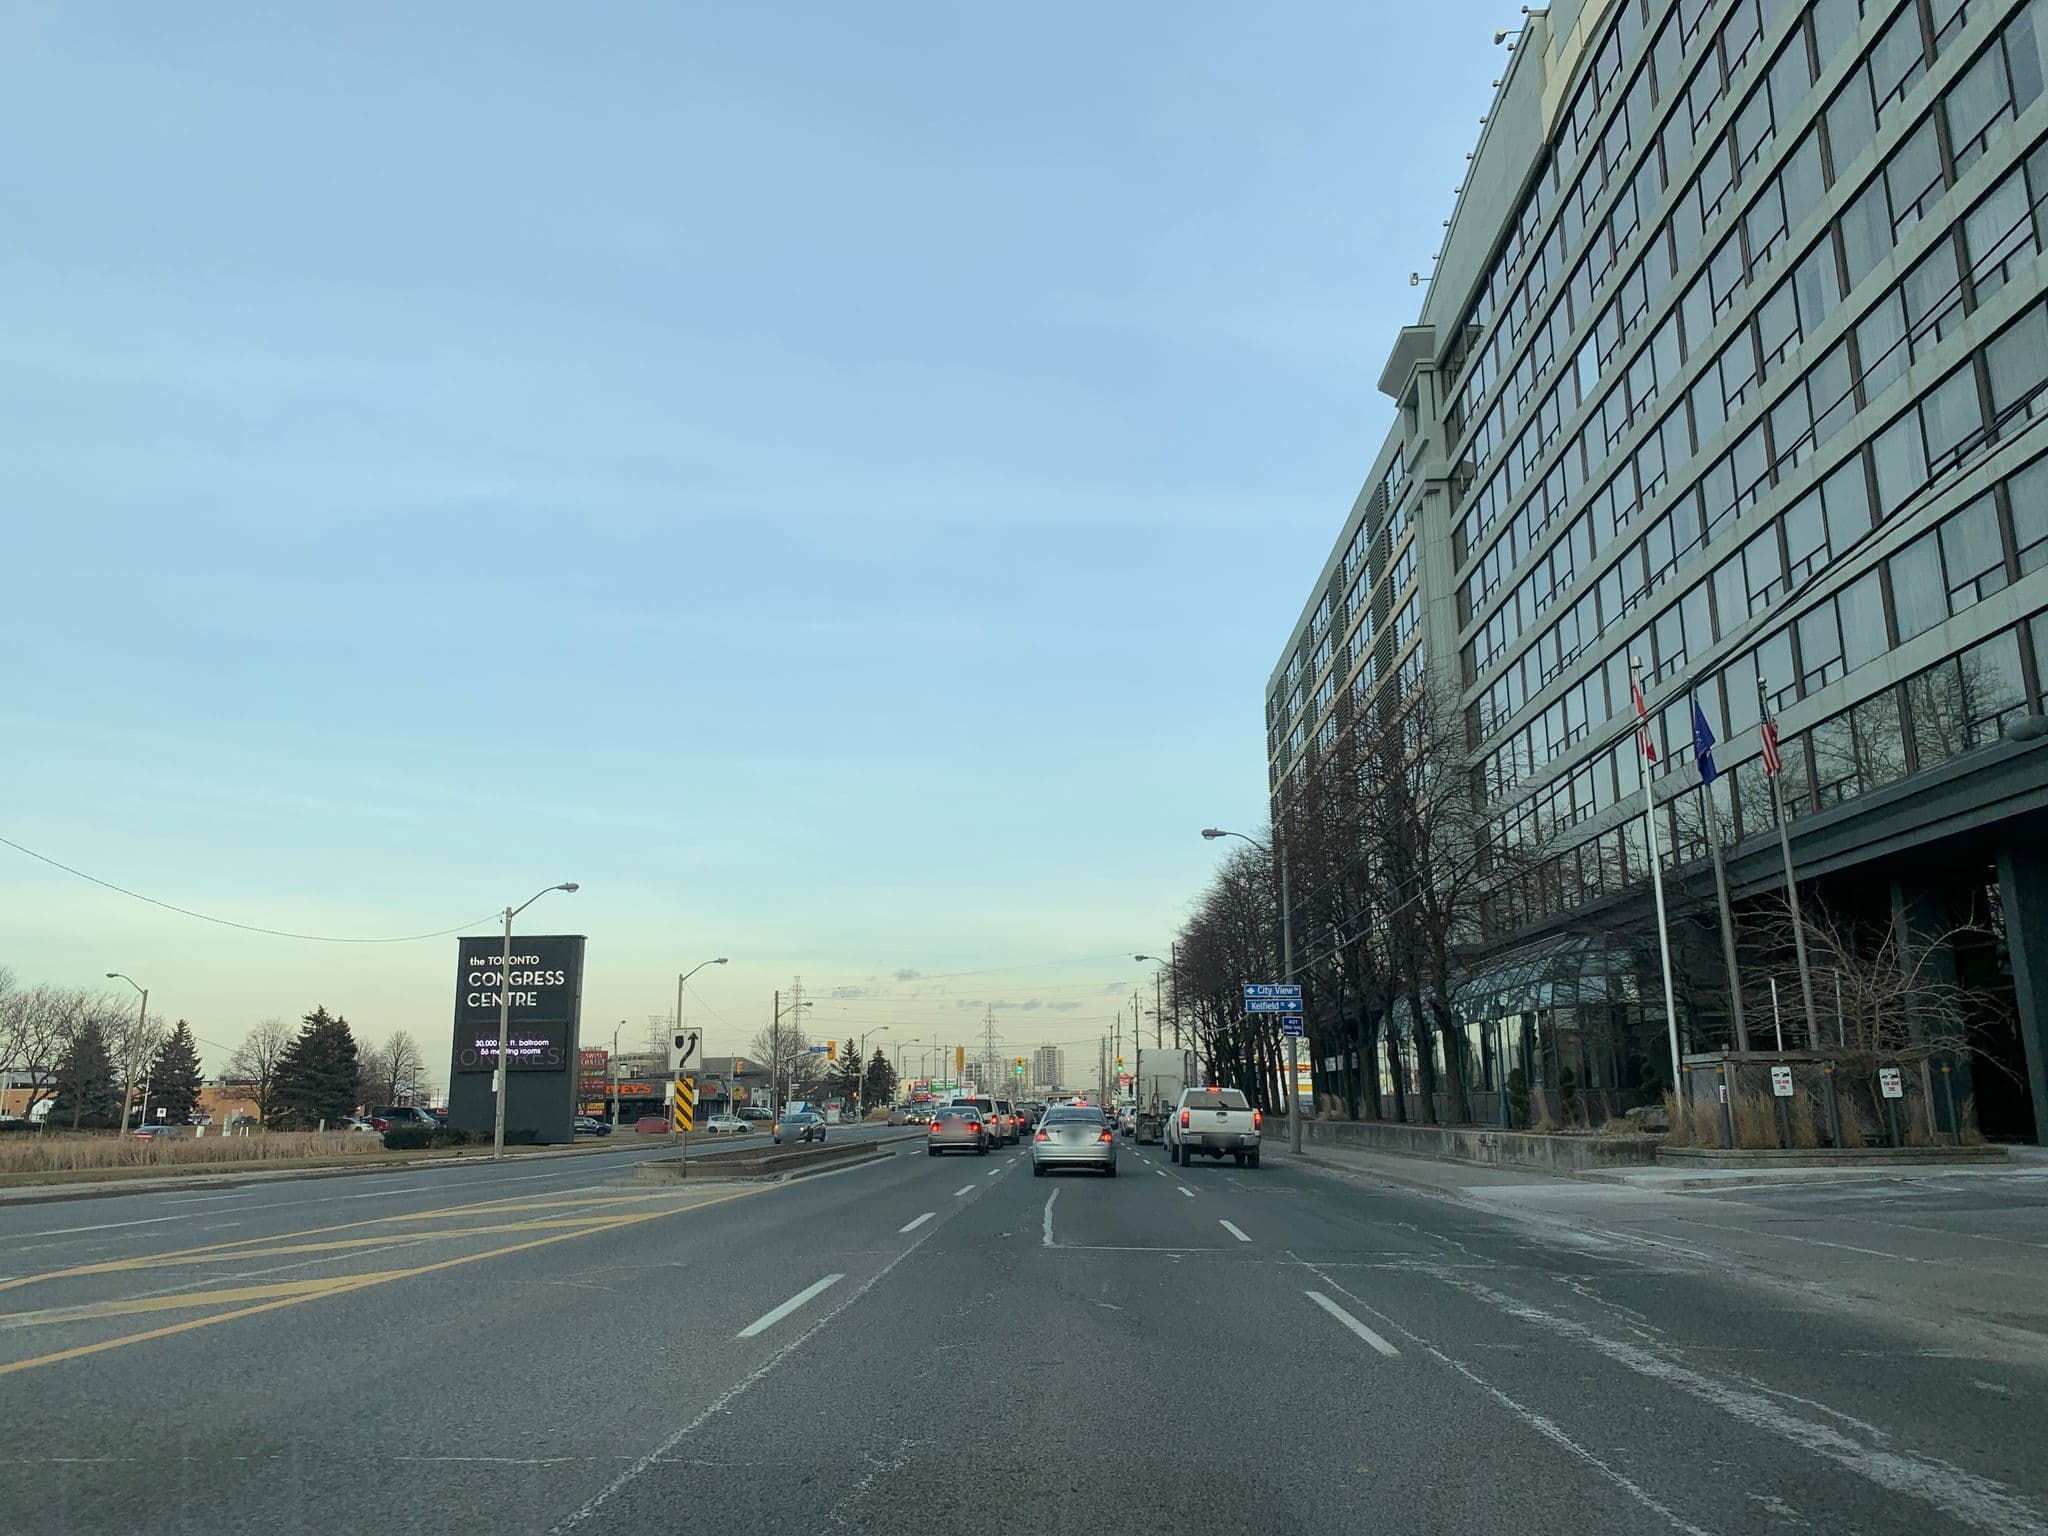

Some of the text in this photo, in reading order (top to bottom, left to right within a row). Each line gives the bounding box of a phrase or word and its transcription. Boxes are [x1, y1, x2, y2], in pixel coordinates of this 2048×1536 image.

[470, 957, 485, 966] the
[1258, 986, 1272, 996] City
[1275, 986, 1293, 994] View
[490, 1048, 519, 1056] meting
